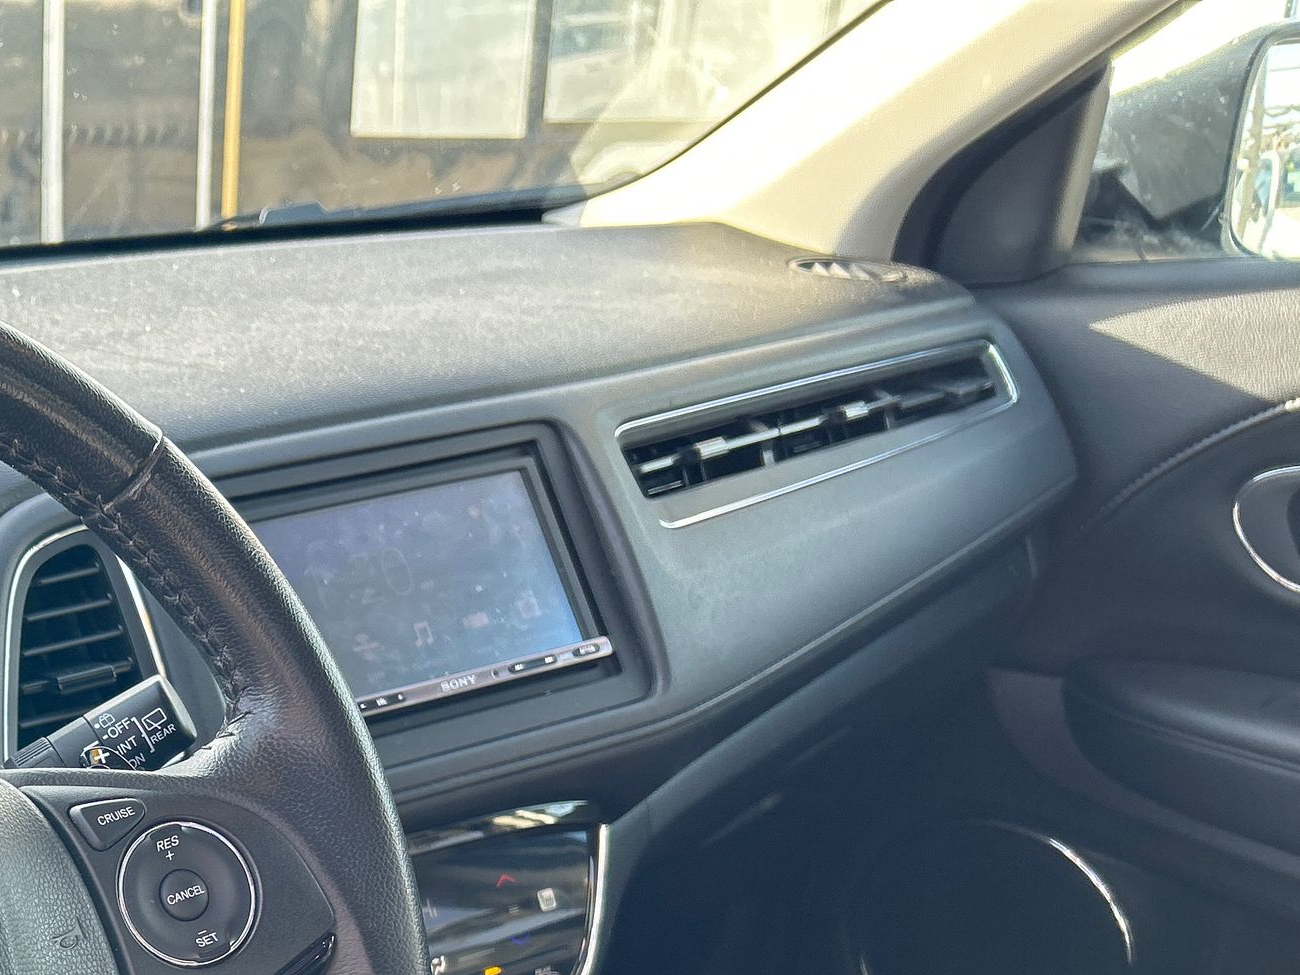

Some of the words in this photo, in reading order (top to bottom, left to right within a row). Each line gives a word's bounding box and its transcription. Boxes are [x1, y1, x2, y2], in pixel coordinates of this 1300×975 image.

[440, 674, 476, 692] SONY
[107, 717, 131, 738] OFF
[150, 723, 176, 744] REAR
[116, 735, 138, 755] INT
[97, 806, 135, 826] CRUISE
[156, 835, 179, 852] RES
[166, 885, 205, 905] CANCEL
[195, 932, 219, 947] SET
